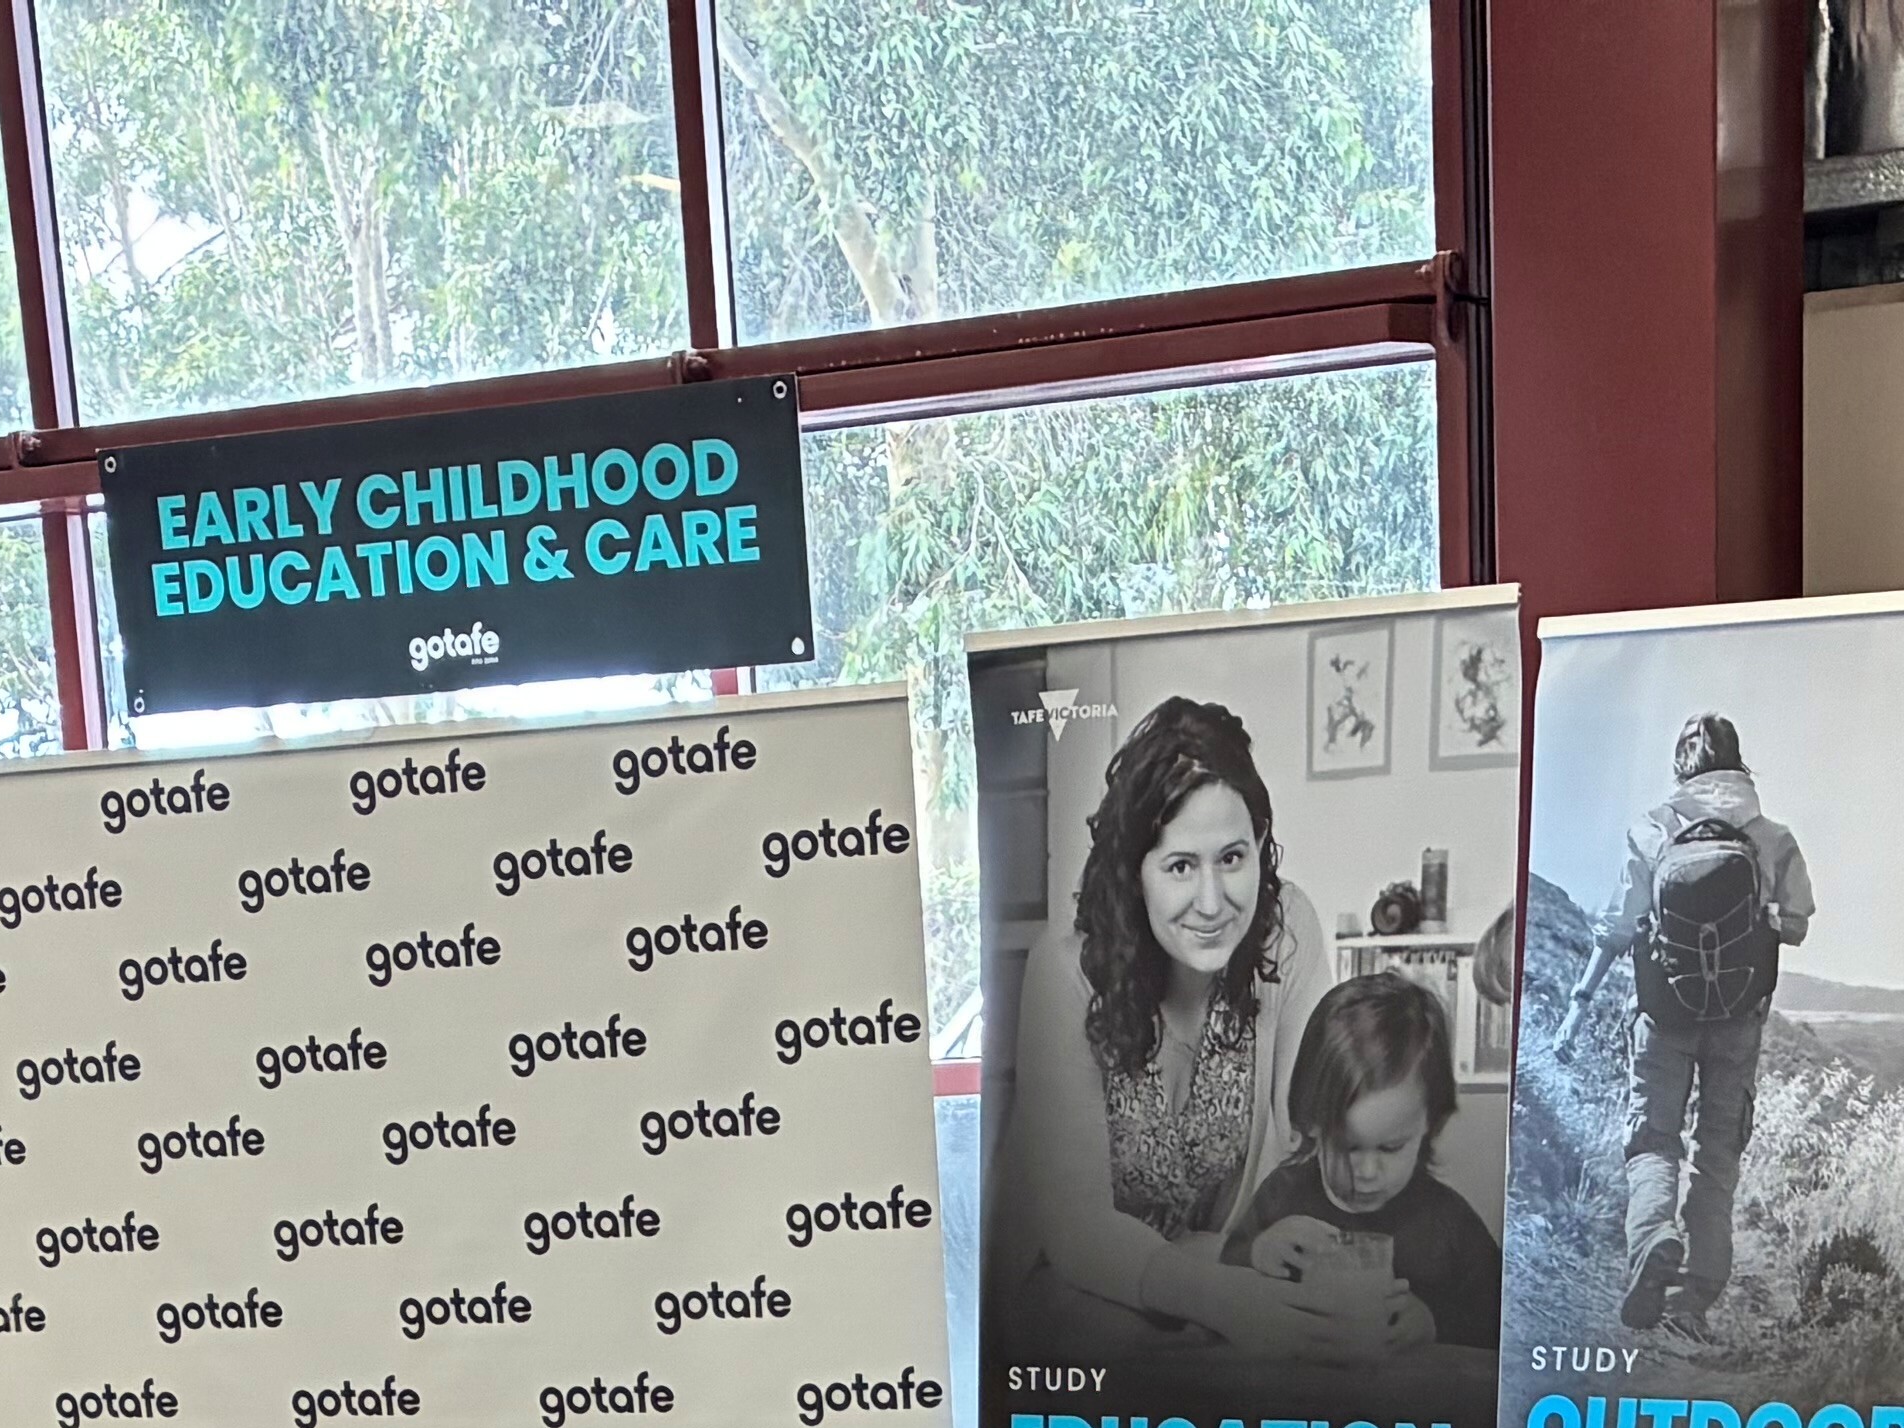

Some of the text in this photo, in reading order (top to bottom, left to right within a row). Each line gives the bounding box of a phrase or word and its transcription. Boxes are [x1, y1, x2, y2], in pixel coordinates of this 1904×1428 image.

[157, 438, 739, 550] EARLY CHILDHOOD
[152, 505, 762, 617] EDUCATION & CARE
[409, 620, 500, 672] gotafe
[1011, 703, 1119, 725] TAFE VICTORIA
[613, 726, 756, 795] gotafe
[763, 809, 909, 878] gotafe
[257, 1028, 386, 1089] gotafe
[775, 999, 920, 1064] gotafe
[655, 1275, 791, 1334] gotafe
[1009, 1367, 1106, 1391] STUDY
[1532, 1346, 1638, 1373] STUDY
